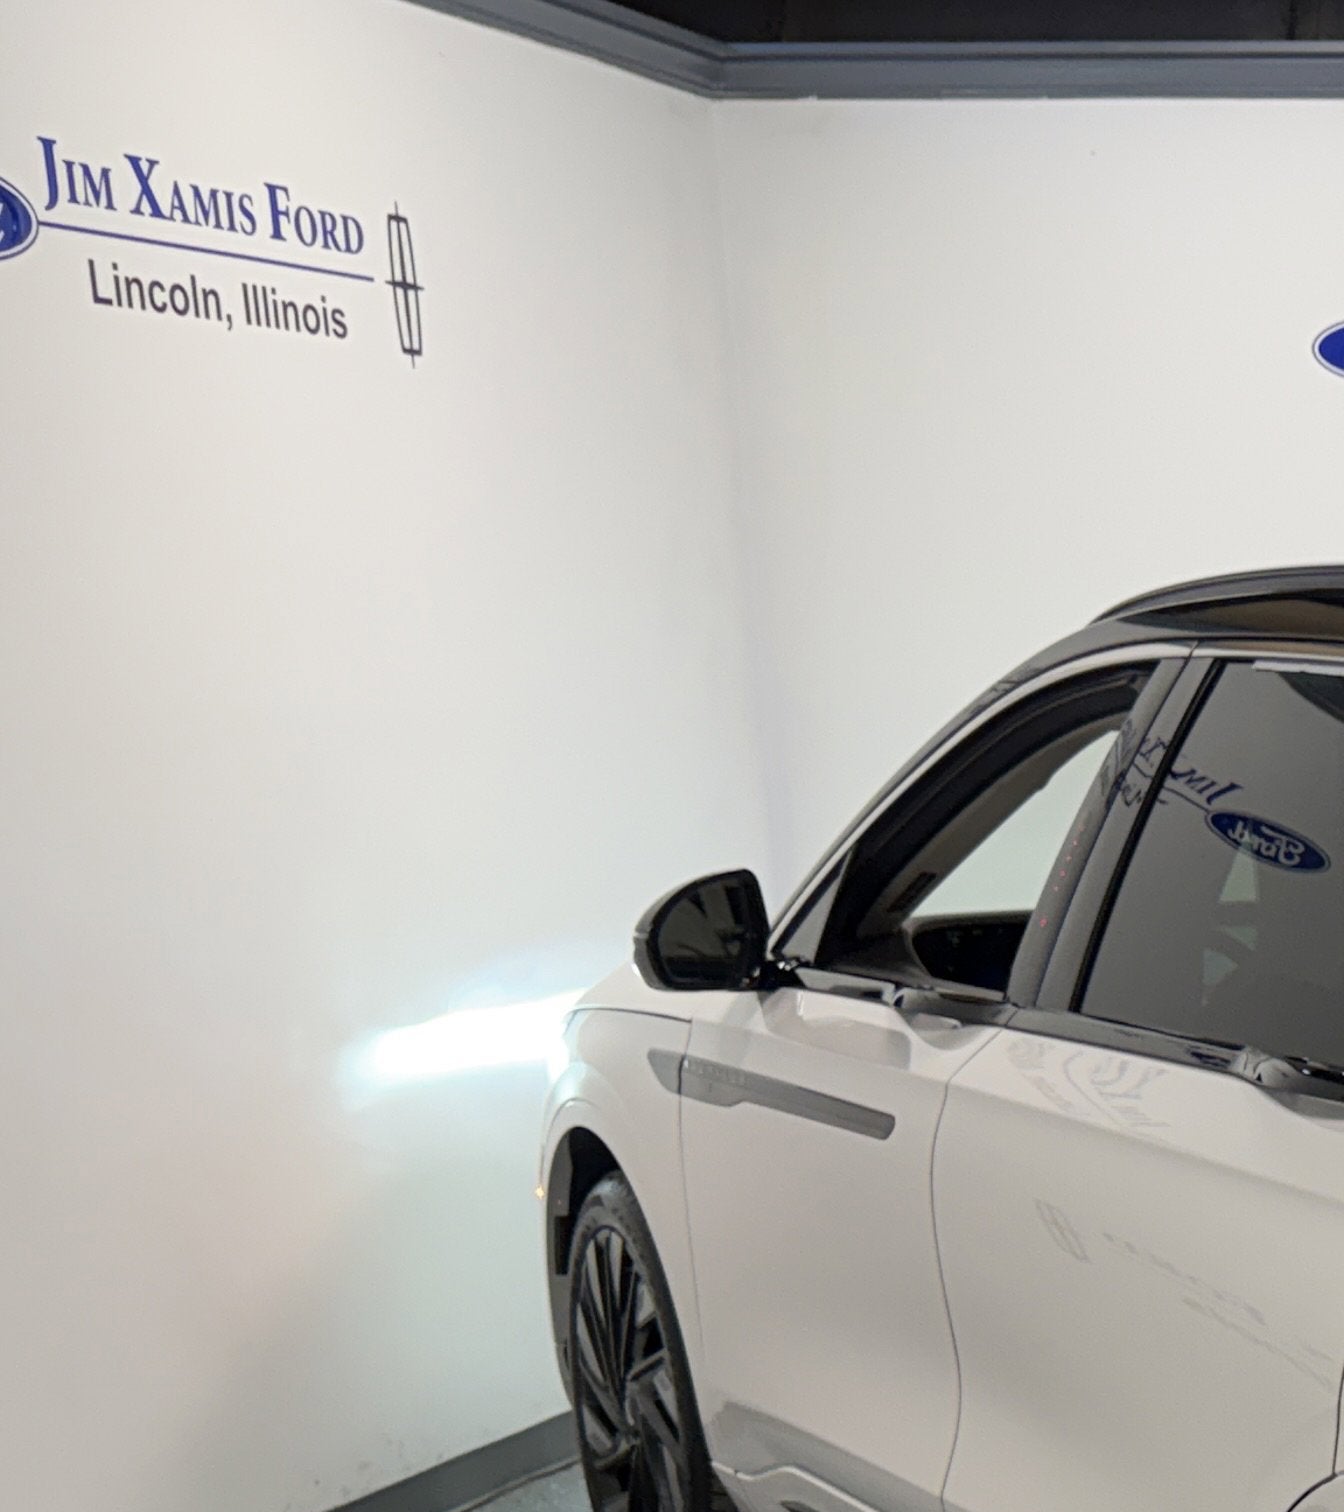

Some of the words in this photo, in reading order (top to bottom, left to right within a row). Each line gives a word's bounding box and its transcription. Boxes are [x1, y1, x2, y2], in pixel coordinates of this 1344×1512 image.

[37, 136, 118, 211] JIM
[123, 153, 257, 236] XAMIS
[263, 182, 365, 255] FORD
[88, 259, 233, 331] Lincoln,
[242, 282, 349, 339] Illinois
